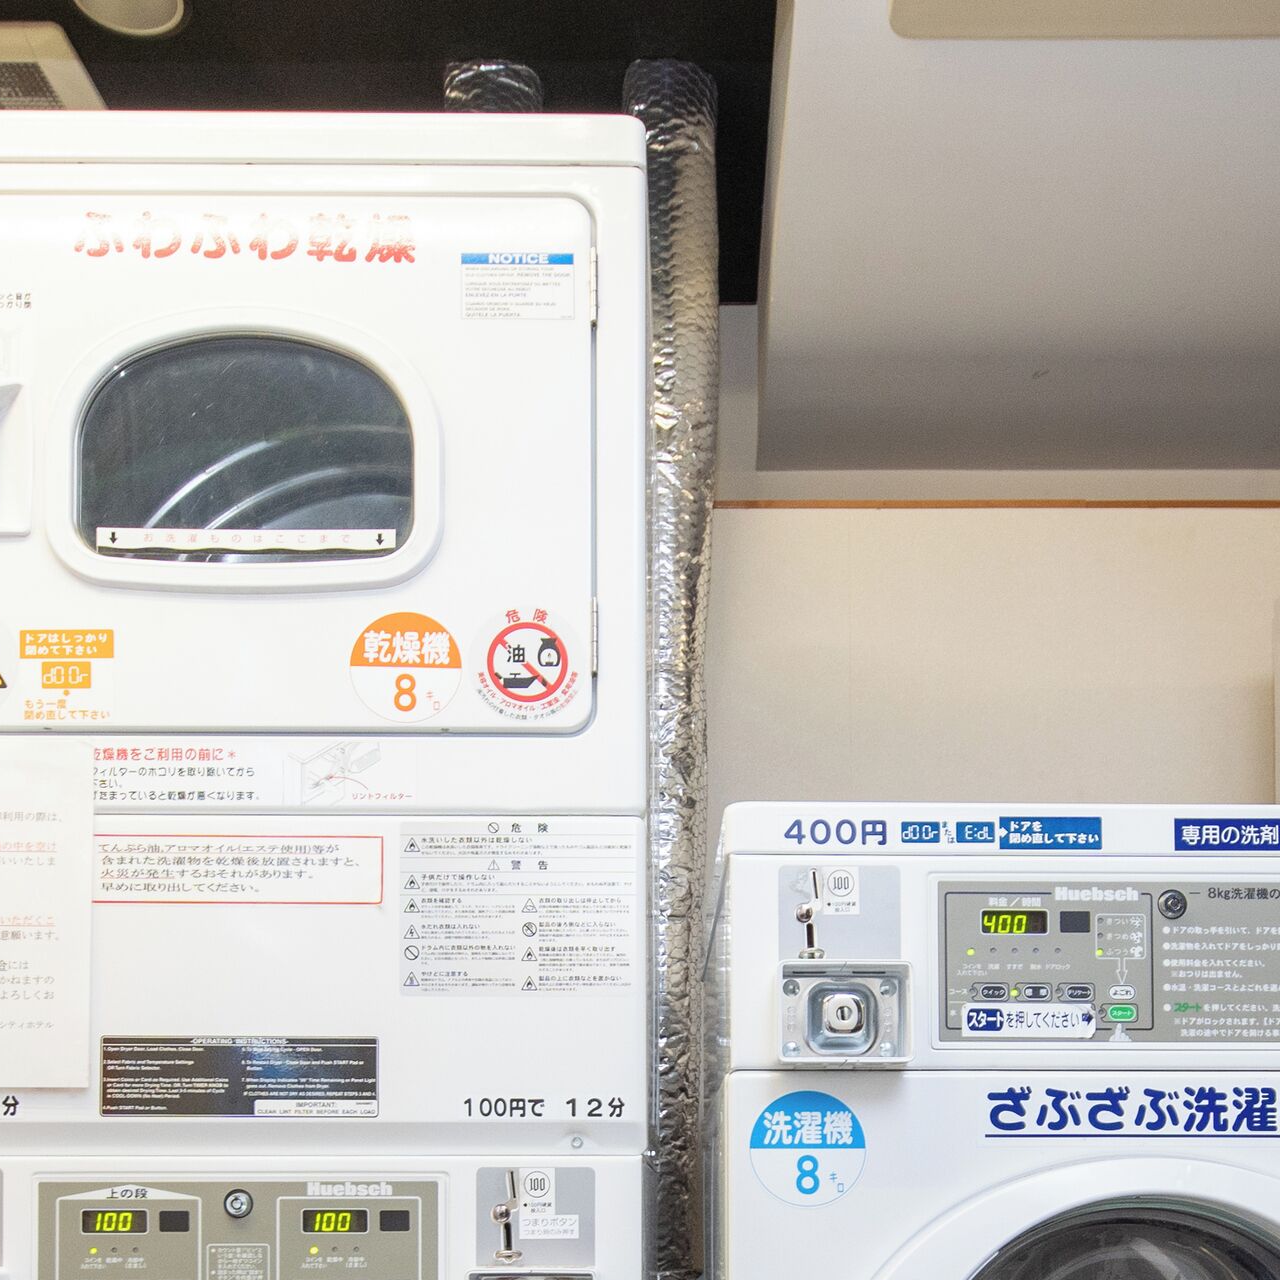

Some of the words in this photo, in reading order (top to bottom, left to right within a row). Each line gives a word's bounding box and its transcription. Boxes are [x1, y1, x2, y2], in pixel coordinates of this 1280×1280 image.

[489, 254, 549, 264] NOTICE
[25, 633, 107, 643] ドアはしっかり
[25, 645, 97, 655] 閉めて下さい
[363, 630, 451, 665] 乾燥機
[507, 645, 525, 663] 油
[394, 674, 416, 712] 8
[784, 819, 887, 846] 400円
[1009, 820, 1040, 831] ドアを
[1009, 832, 1099, 845] 閉め直して下さい
[1055, 887, 1139, 901] Huebsch
[984, 915, 1026, 933] 400
[464, 1098, 545, 1117] 100円で
[566, 1097, 625, 1117] 12分
[763, 1111, 854, 1147] 洗濯機
[796, 1154, 820, 1195] 8
[106, 1188, 148, 1199] 上の段
[307, 1182, 393, 1196] Huebsch
[529, 1178, 545, 1191] 100
[95, 1212, 133, 1231] 100
[314, 1213, 351, 1232] 100
